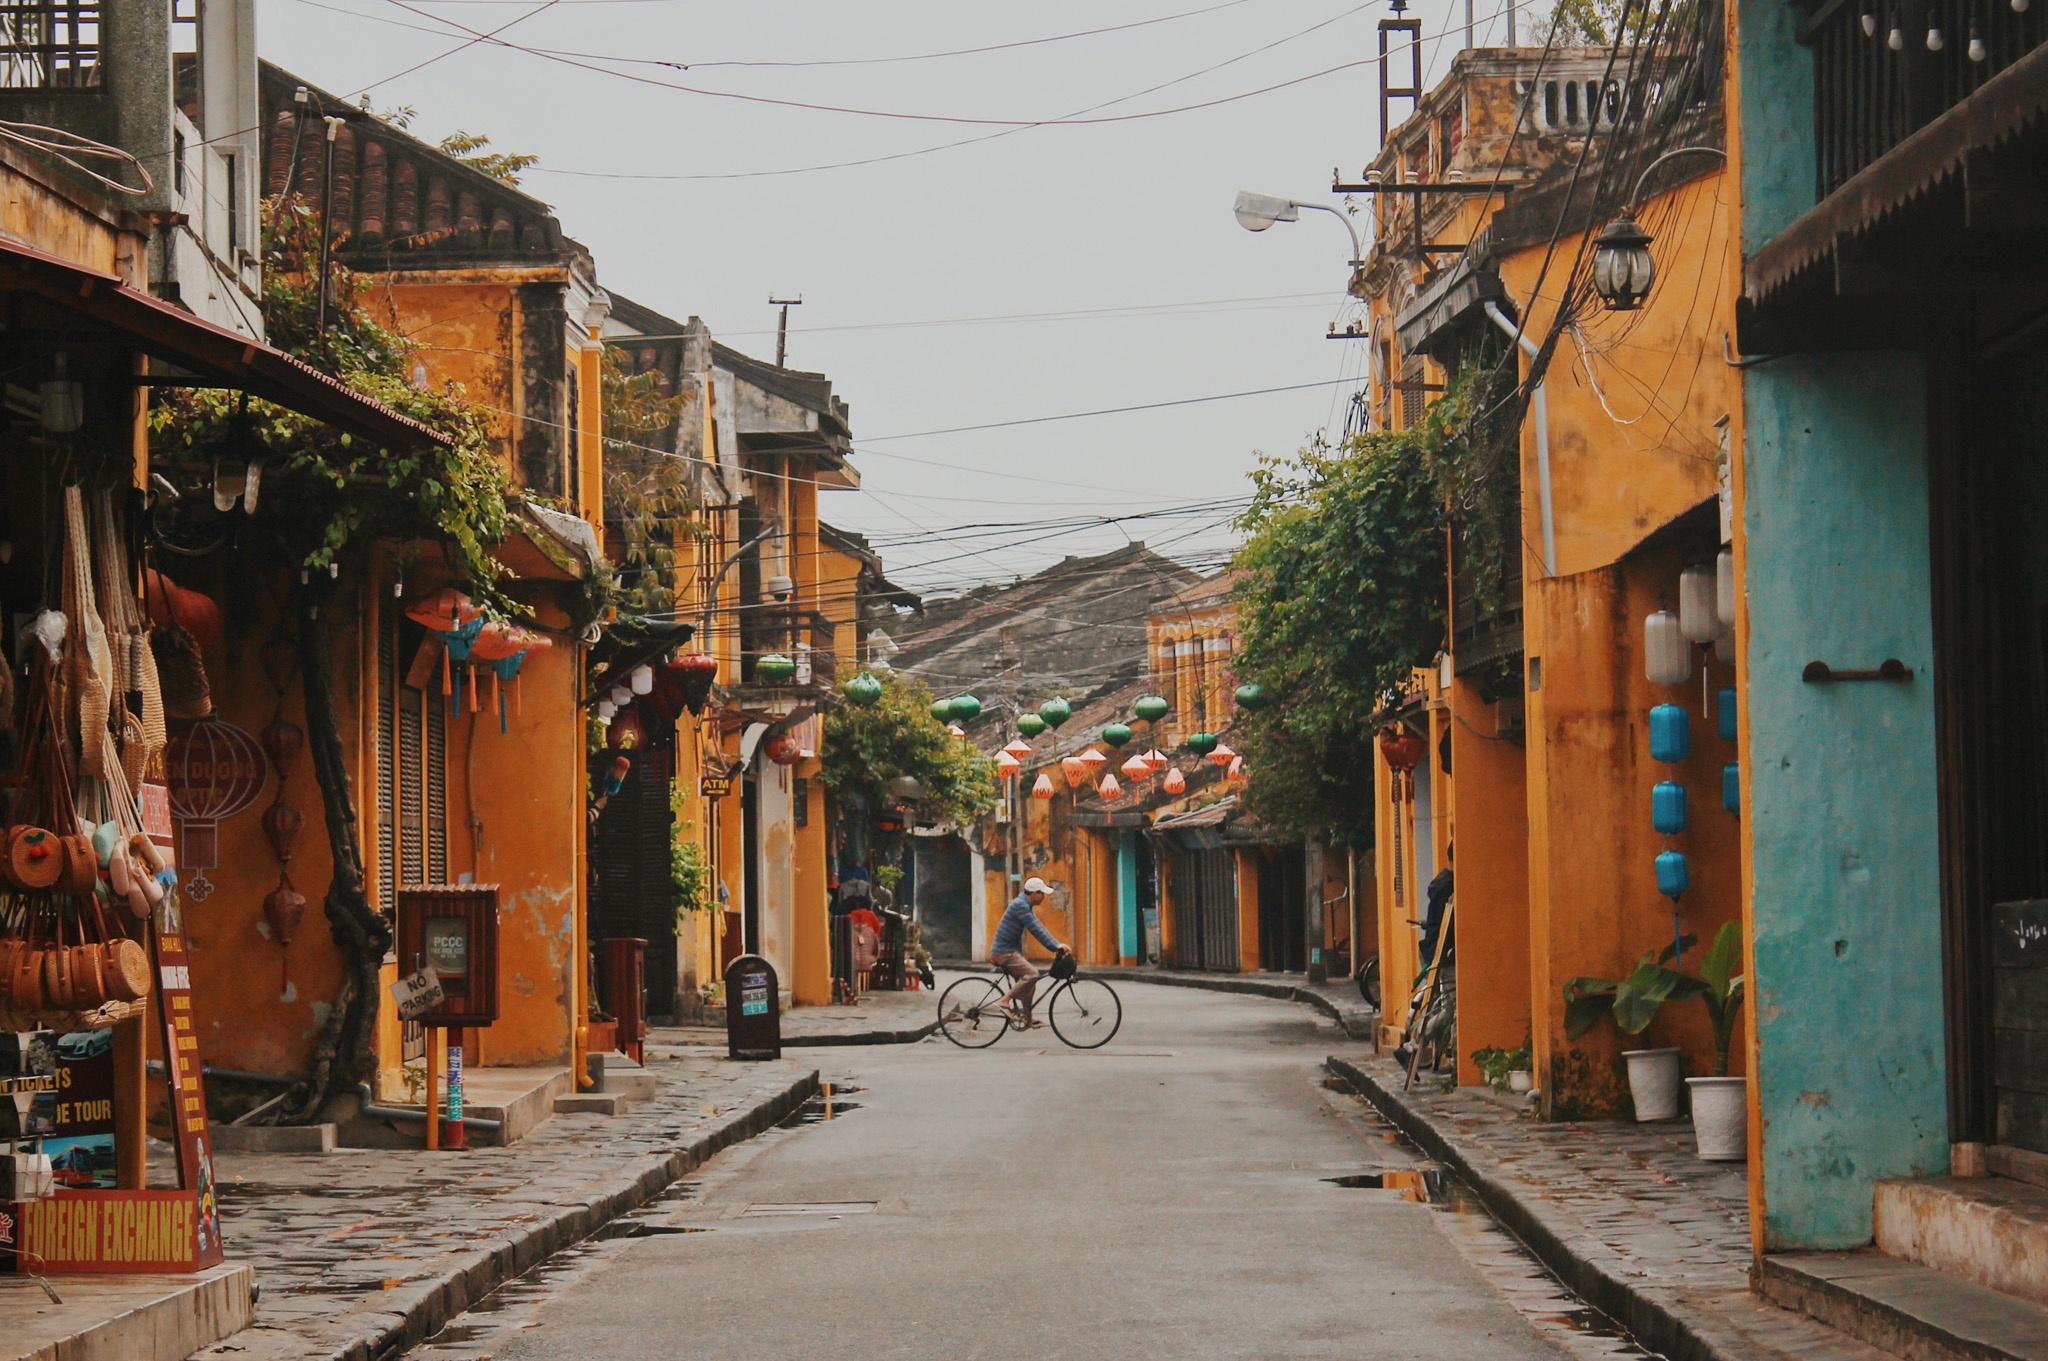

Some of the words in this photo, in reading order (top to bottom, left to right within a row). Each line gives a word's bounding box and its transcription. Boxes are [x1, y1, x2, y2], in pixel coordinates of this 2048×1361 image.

[702, 779, 729, 789] ATM
[433, 936, 464, 948] PCCC
[406, 976, 427, 993] NO
[401, 985, 441, 1012] PARKING
[74, 1099, 112, 1122] TOUR
[24, 1199, 97, 1262] FOREIGN
[103, 1200, 194, 1262] EXCHANGE
